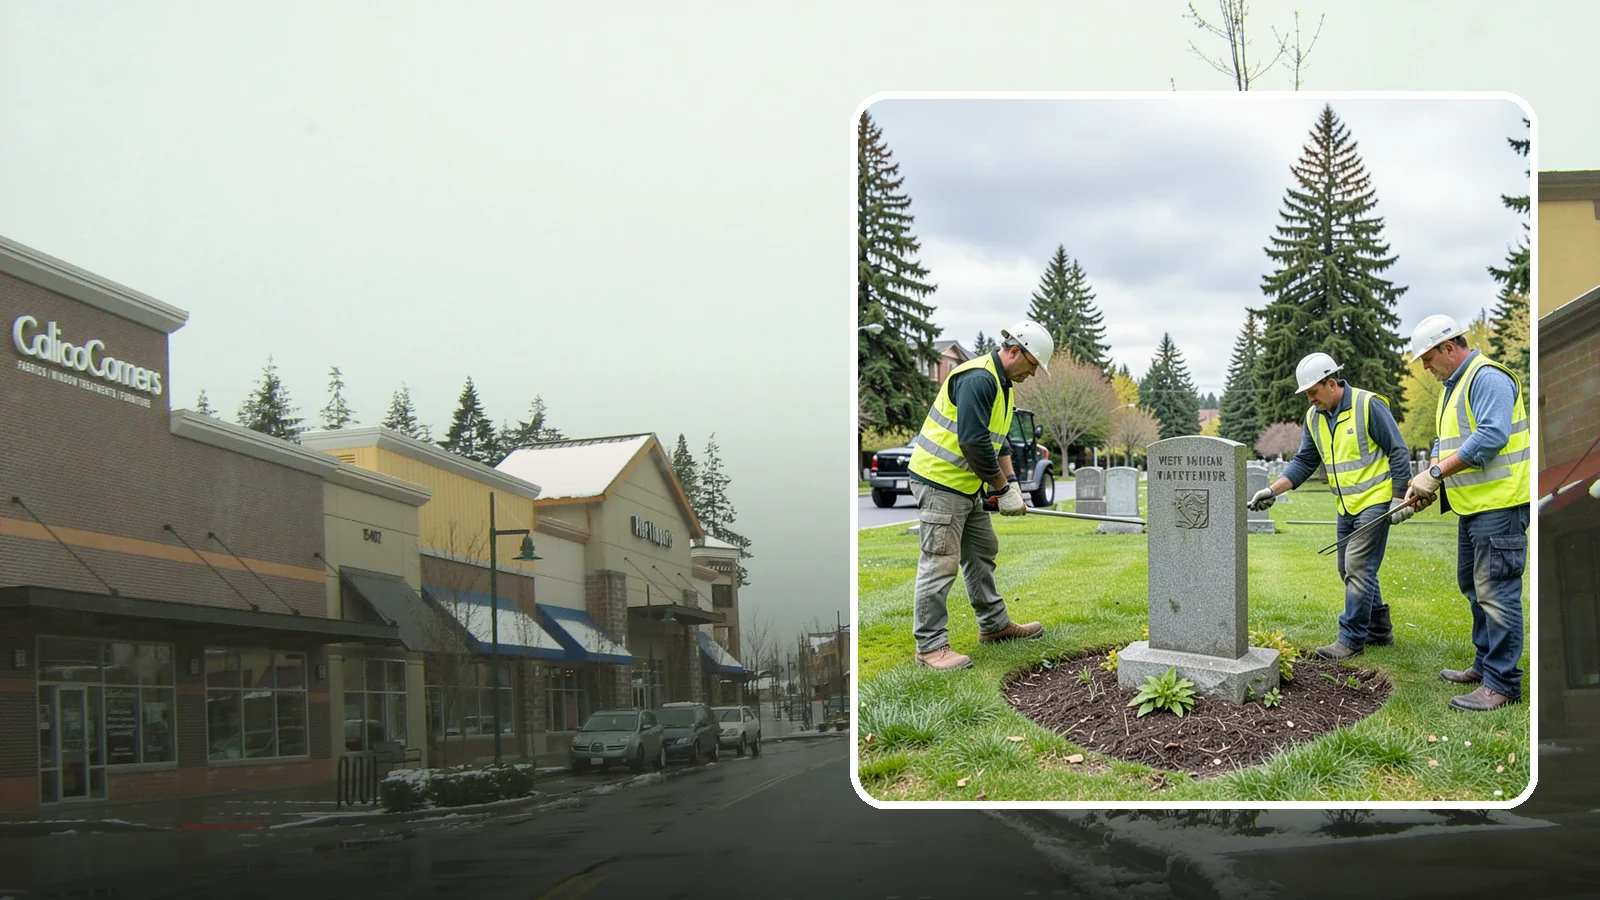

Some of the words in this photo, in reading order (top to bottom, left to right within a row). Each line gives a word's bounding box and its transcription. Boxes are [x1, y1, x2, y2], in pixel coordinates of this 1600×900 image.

[16, 360, 47, 377] FABRICS
[51, 370, 78, 386] WINDOW
[79, 378, 117, 398] TREATMENTS
